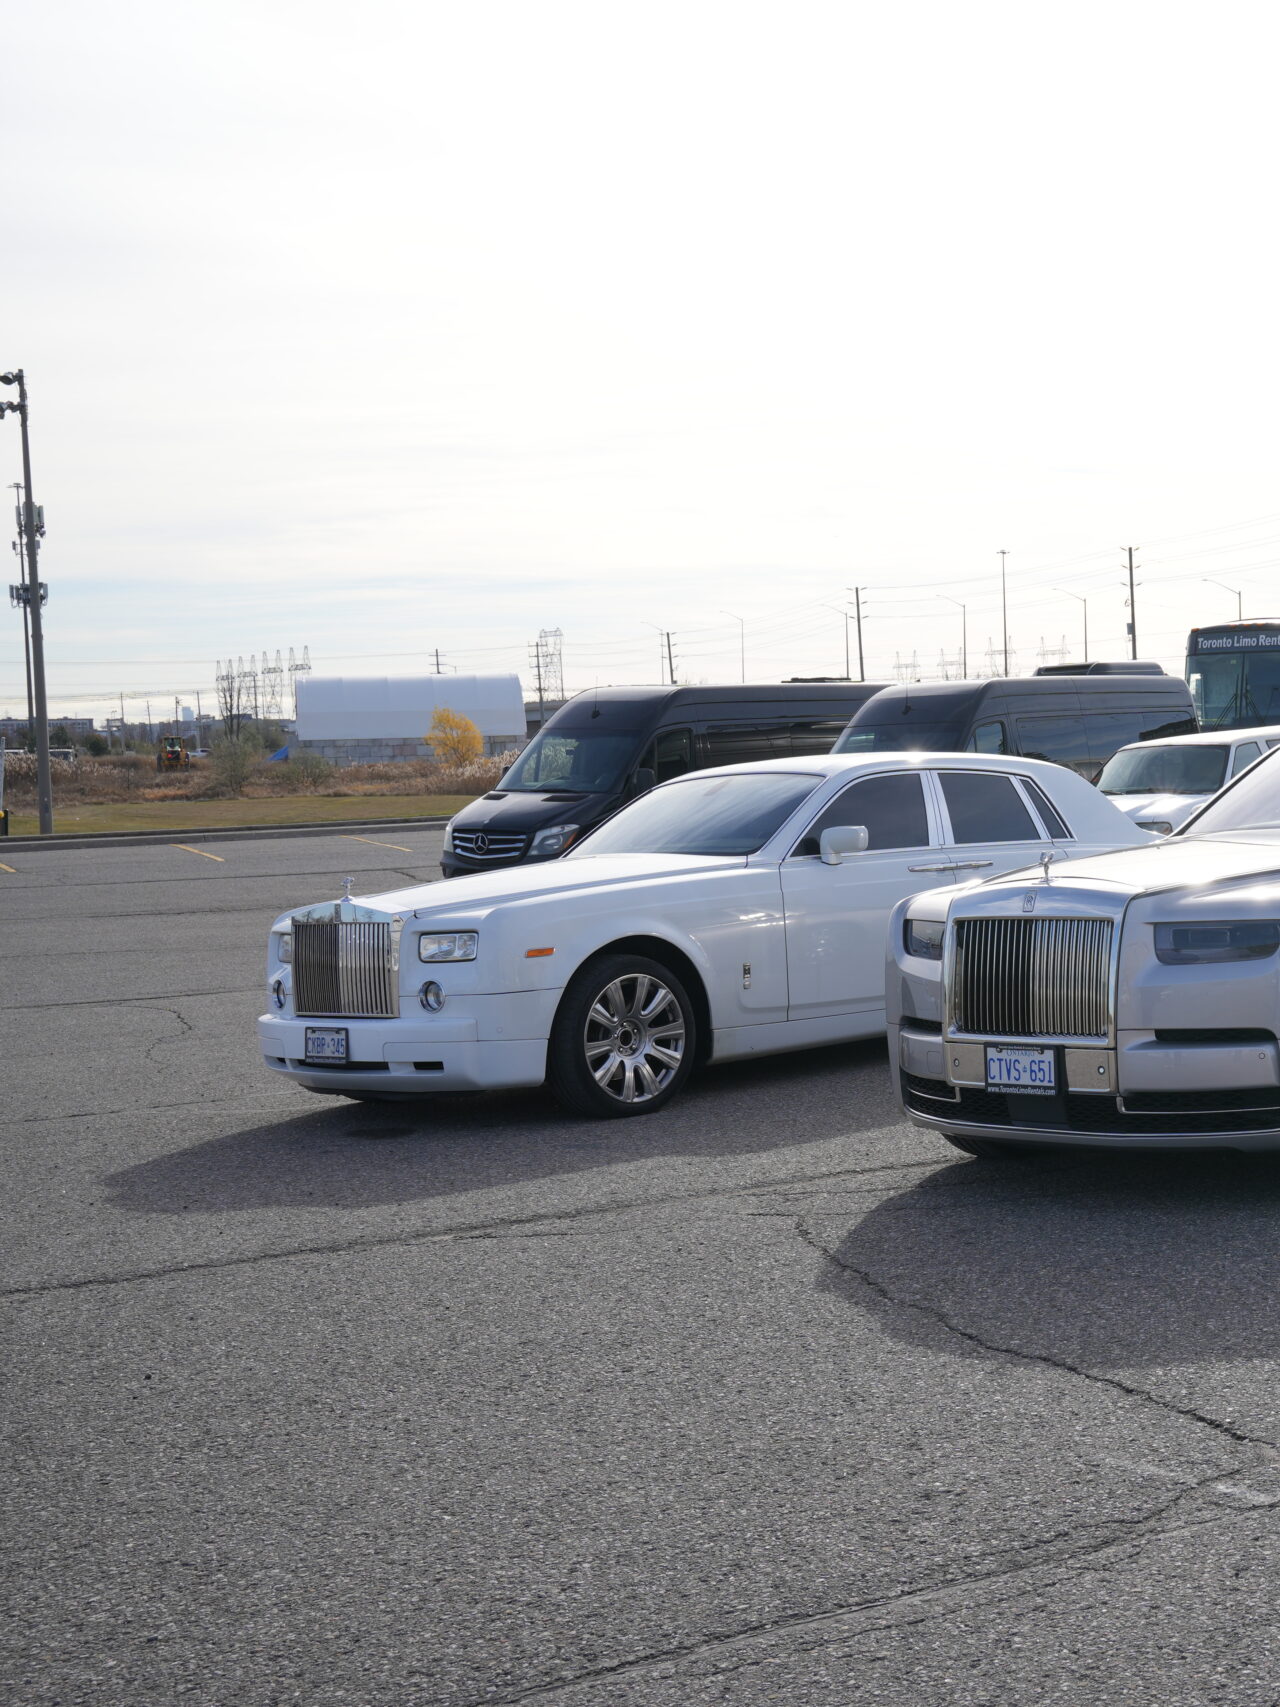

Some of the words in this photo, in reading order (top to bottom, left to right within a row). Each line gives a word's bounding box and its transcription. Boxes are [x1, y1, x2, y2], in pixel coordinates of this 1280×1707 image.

[1197, 637, 1233, 649] Toronto
[1233, 635, 1257, 647] Limo
[330, 1037, 345, 1056] 345
[1006, 1049, 1035, 1057] ONTARIO
[988, 1057, 1021, 1081] CTVS
[1029, 1059, 1053, 1083] 651
